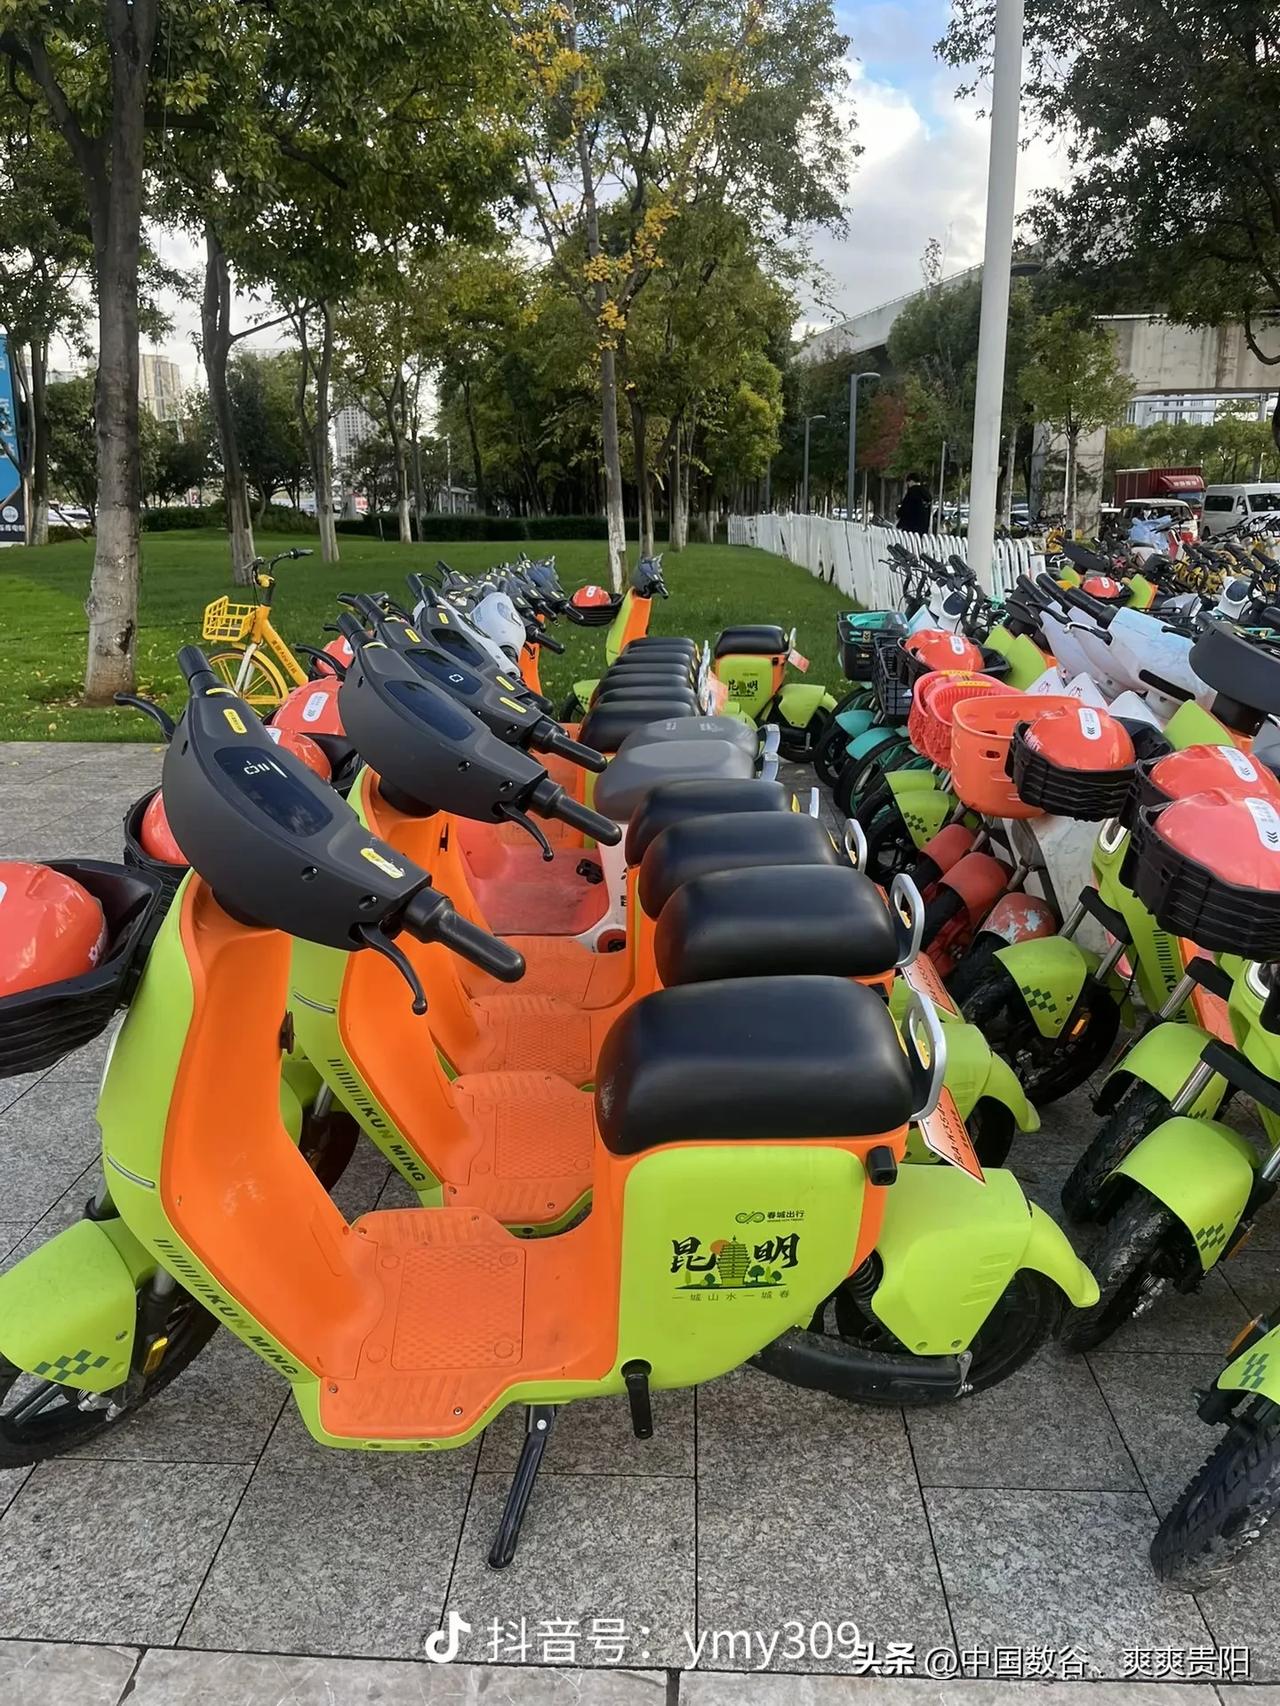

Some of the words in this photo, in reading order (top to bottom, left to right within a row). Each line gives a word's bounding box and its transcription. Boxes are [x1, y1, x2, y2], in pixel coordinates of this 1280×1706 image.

[361, 1107, 394, 1139] KUN
[390, 1144, 426, 1181] MING
[767, 1210, 805, 1219] 春城出行
[205, 1294, 252, 1330] KUN
[248, 1335, 299, 1375] MING
